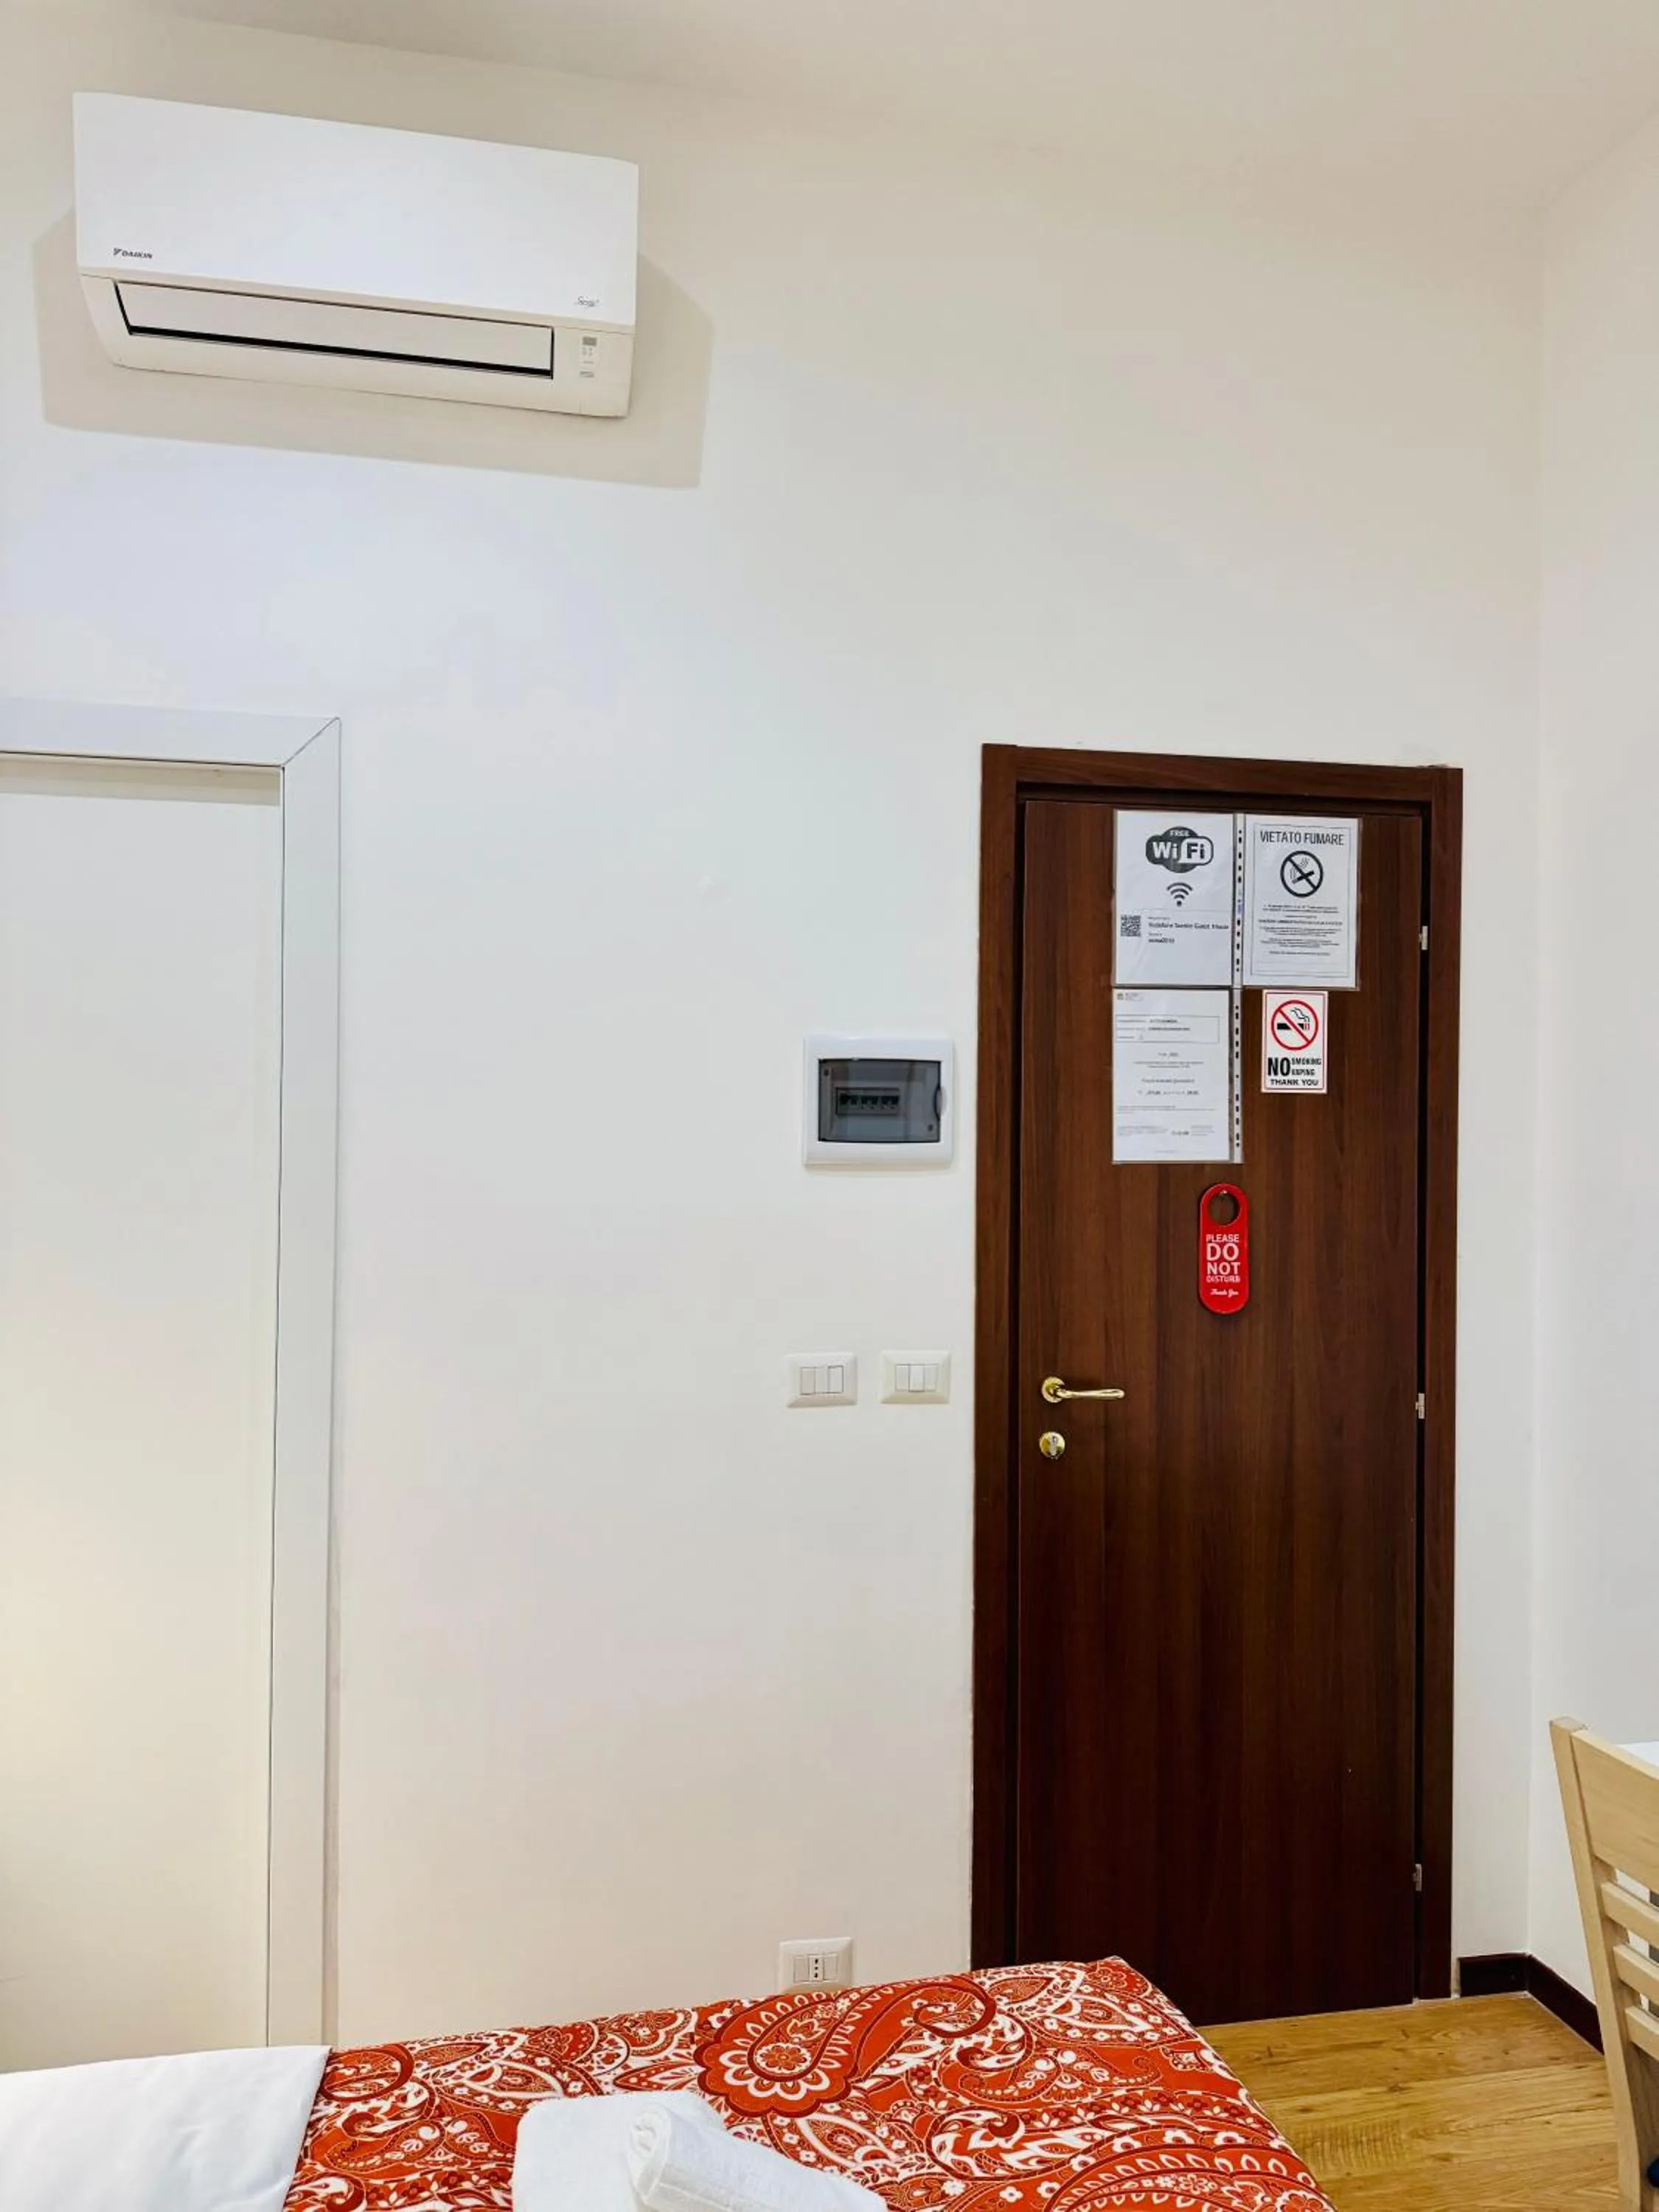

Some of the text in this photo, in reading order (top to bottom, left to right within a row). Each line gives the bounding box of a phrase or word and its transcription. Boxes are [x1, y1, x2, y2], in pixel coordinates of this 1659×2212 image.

[1260, 830, 1344, 846] VIETATO FUMARE
[1267, 1057, 1290, 1077] NO
[1206, 1234, 1239, 1242] PLEASE
[1206, 1242, 1239, 1262] DO
[1207, 1262, 1241, 1275] NOT
[1206, 1275, 1241, 1283] DISTURB
